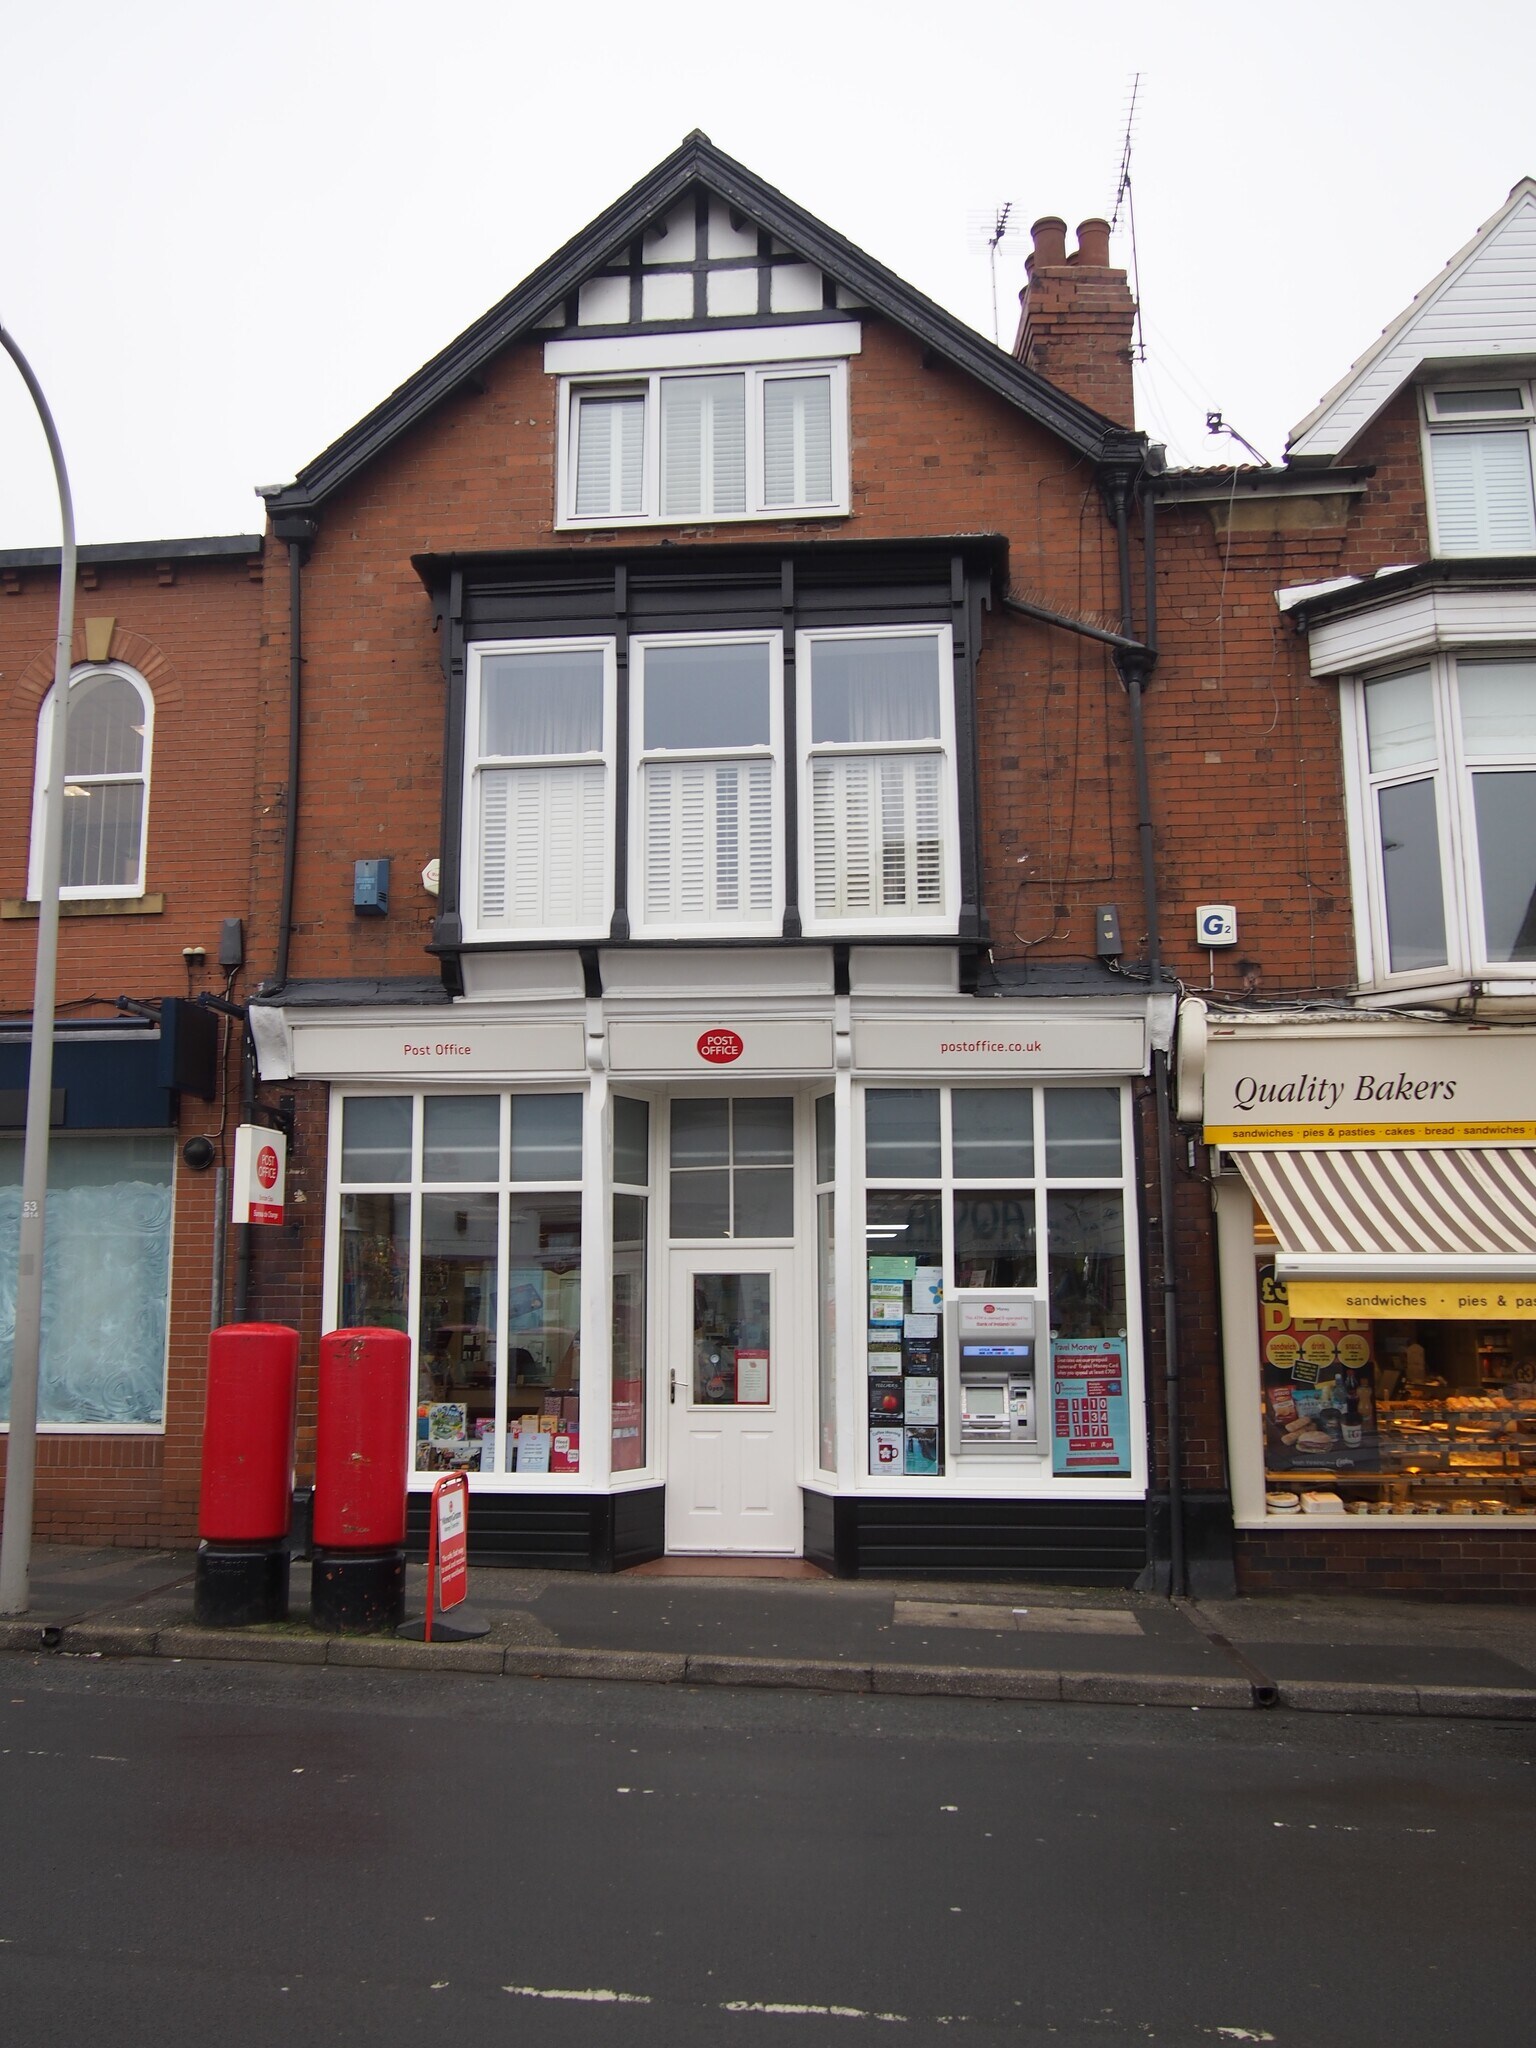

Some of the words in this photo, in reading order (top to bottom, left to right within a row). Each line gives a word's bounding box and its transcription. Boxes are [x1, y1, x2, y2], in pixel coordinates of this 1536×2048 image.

[707, 1036, 734, 1046] POST
[403, 1044, 431, 1056] Post
[435, 1044, 471, 1056] Office
[701, 1045, 739, 1055] OFFICE
[941, 1040, 1042, 1054] postoffice.co.uk
[1232, 1074, 1345, 1111] Quality
[1353, 1072, 1457, 1102] Bakers
[1232, 1129, 1294, 1138] sandwiches
[1302, 1128, 1325, 1139] pies
[1327, 1128, 1335, 1137] &
[1338, 1127, 1376, 1138] pasties
[1384, 1127, 1416, 1136] cakes
[1424, 1127, 1455, 1135] bread
[1463, 1126, 1525, 1135] sandwiches
[261, 1154, 275, 1167] POST
[258, 1166, 277, 1179] OFFICE
[23, 1201, 38, 1211] 53
[1346, 1295, 1427, 1306] sandwiches
[1458, 1296, 1488, 1309] pies
[1497, 1295, 1507, 1307] &
[1055, 1343, 1070, 1351] Travel
[1071, 1343, 1098, 1352] Money
[1072, 1399, 1106, 1409] 1.10
[1073, 1412, 1107, 1422] 1.34
[1075, 1425, 1107, 1436] 1.71
